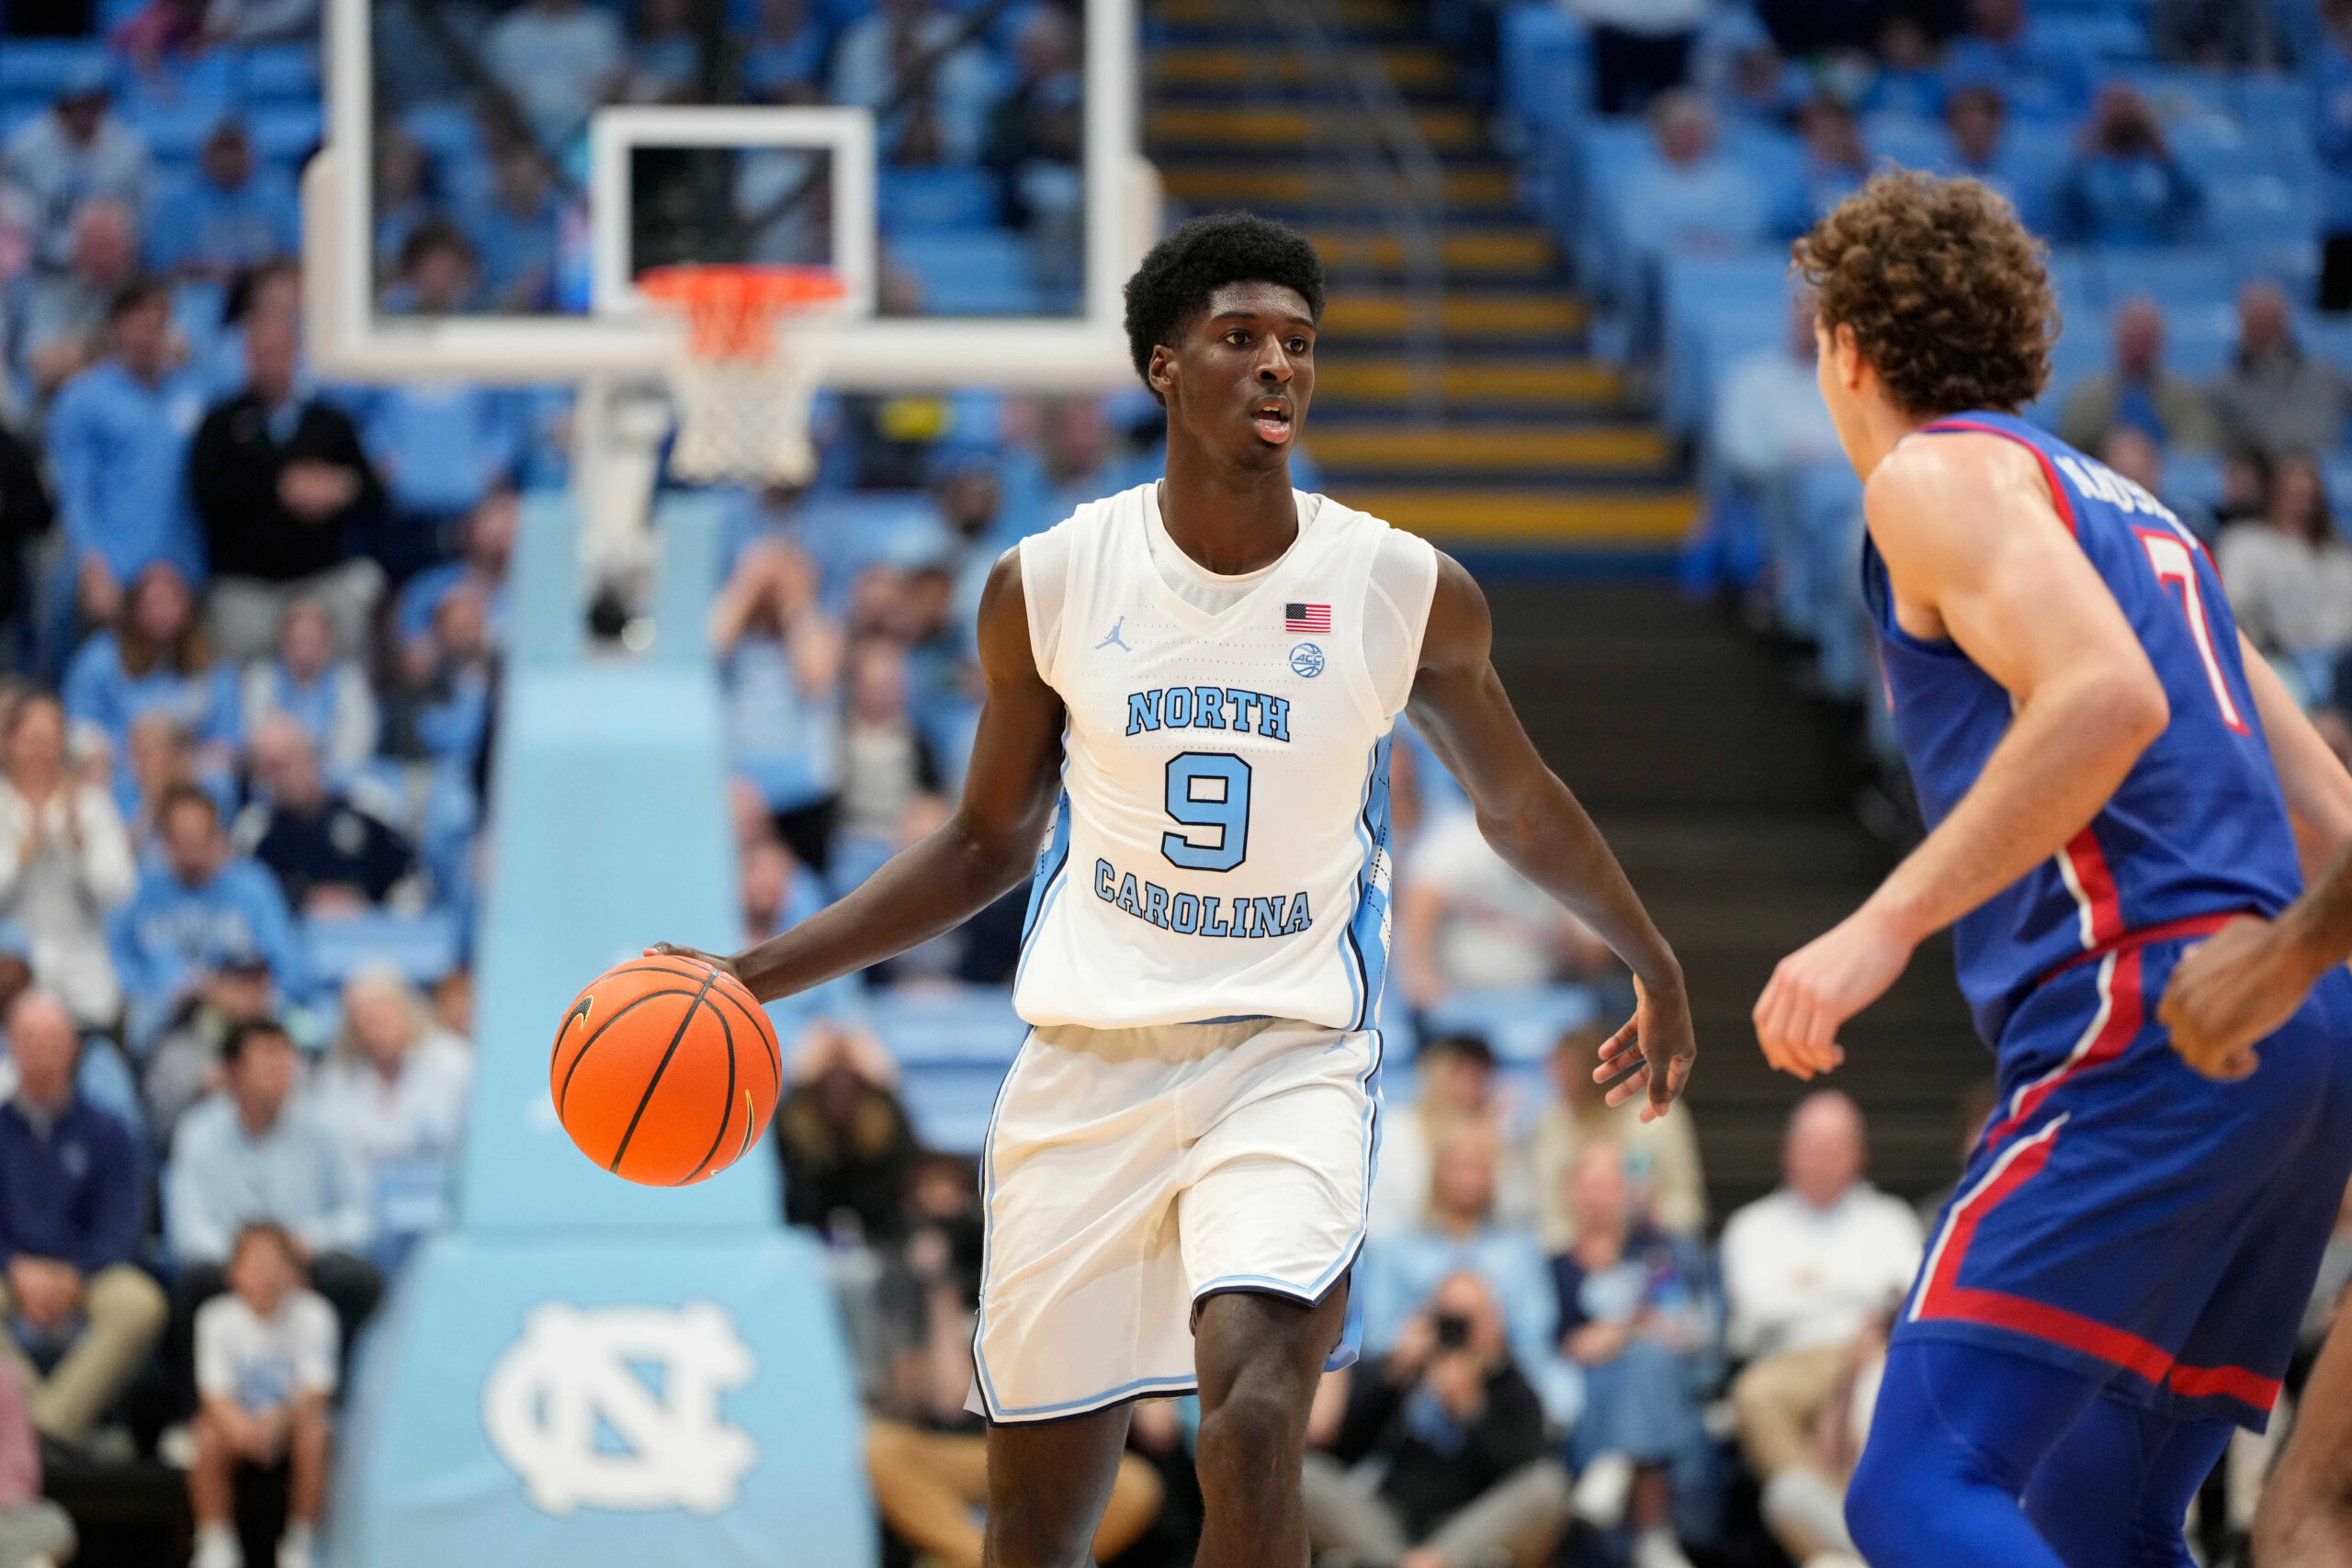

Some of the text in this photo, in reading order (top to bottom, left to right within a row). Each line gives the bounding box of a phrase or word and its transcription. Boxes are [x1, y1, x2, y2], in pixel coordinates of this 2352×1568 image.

[1293, 654, 1323, 666] ACC
[2131, 524, 2251, 737] 7
[1125, 686, 1291, 742] NORTH
[1160, 751, 1252, 873] 9
[1094, 857, 1312, 939] CAROLINA
